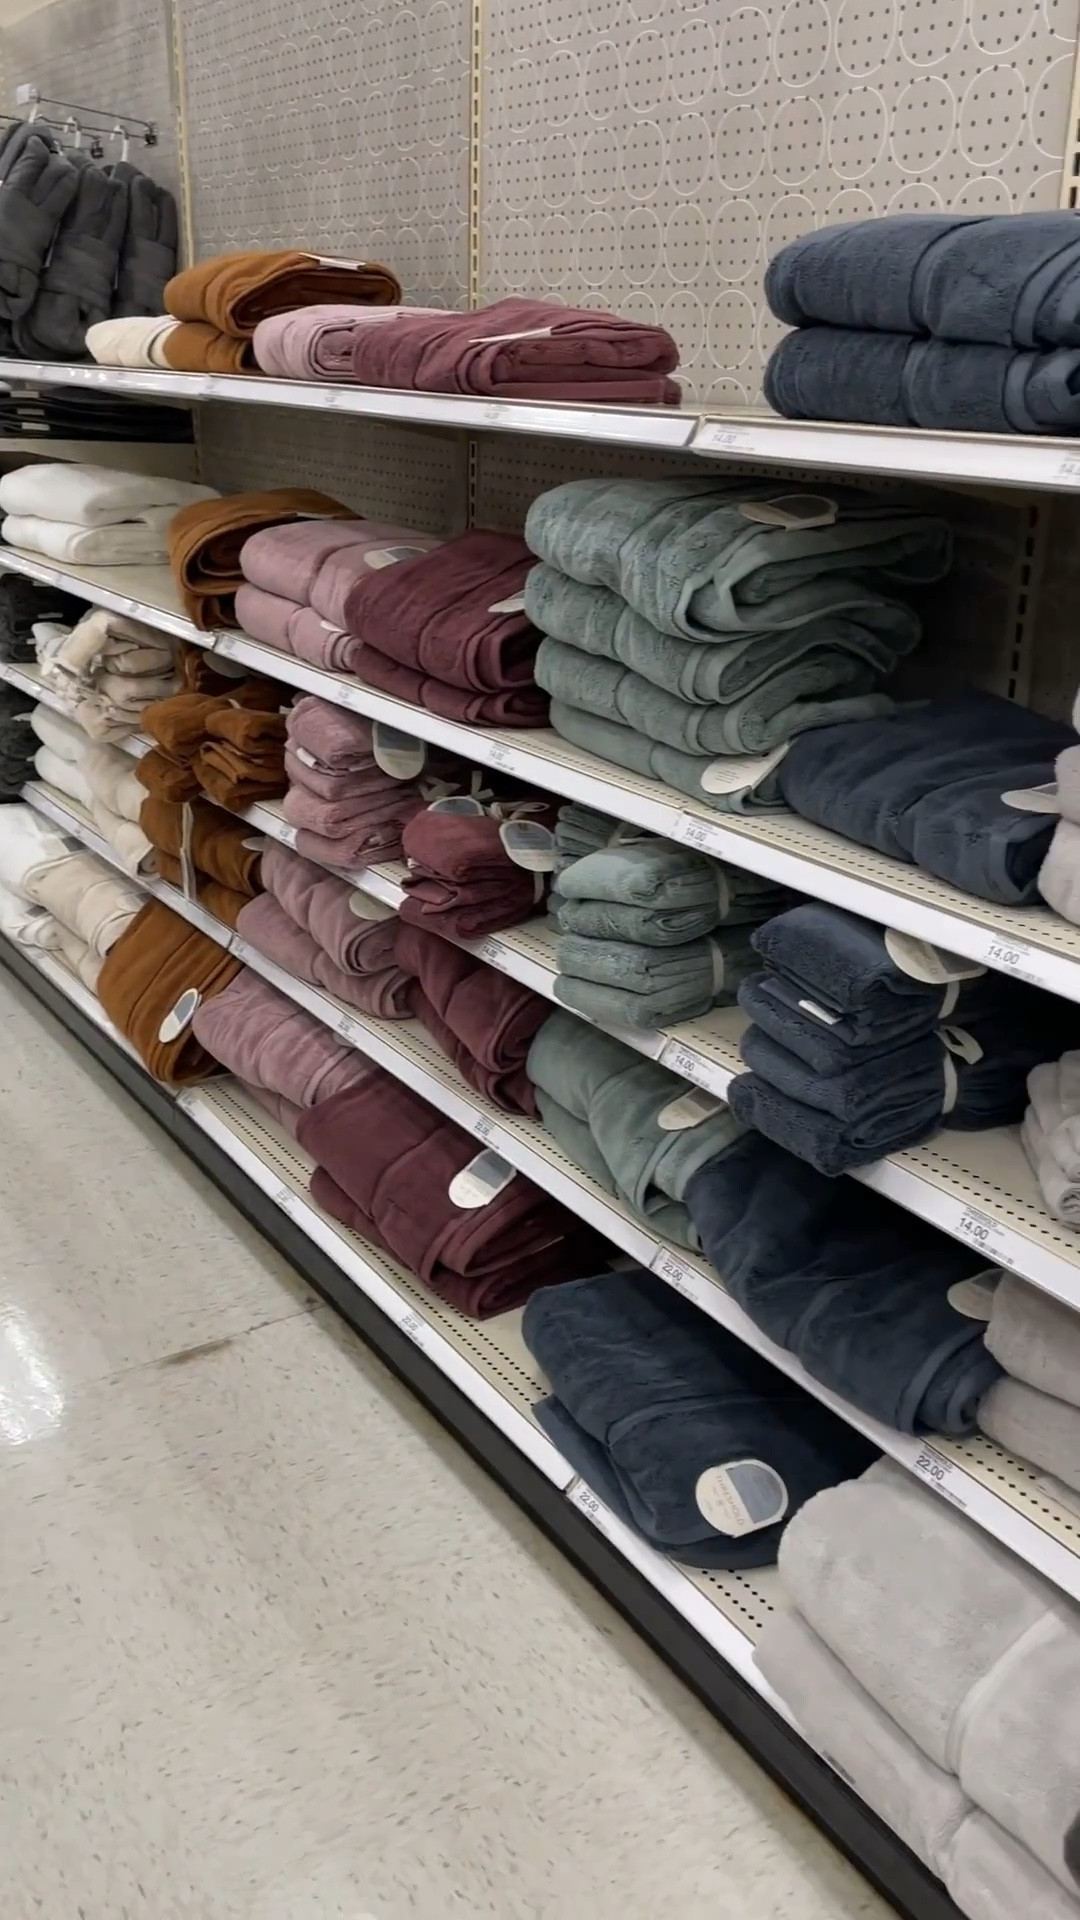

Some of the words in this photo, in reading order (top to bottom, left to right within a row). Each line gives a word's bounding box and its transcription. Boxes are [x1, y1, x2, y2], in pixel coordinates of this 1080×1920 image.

[988, 945, 1020, 965] 14.00
[960, 1217, 989, 1240] 14.00
[916, 1455, 945, 1480] 22.00
